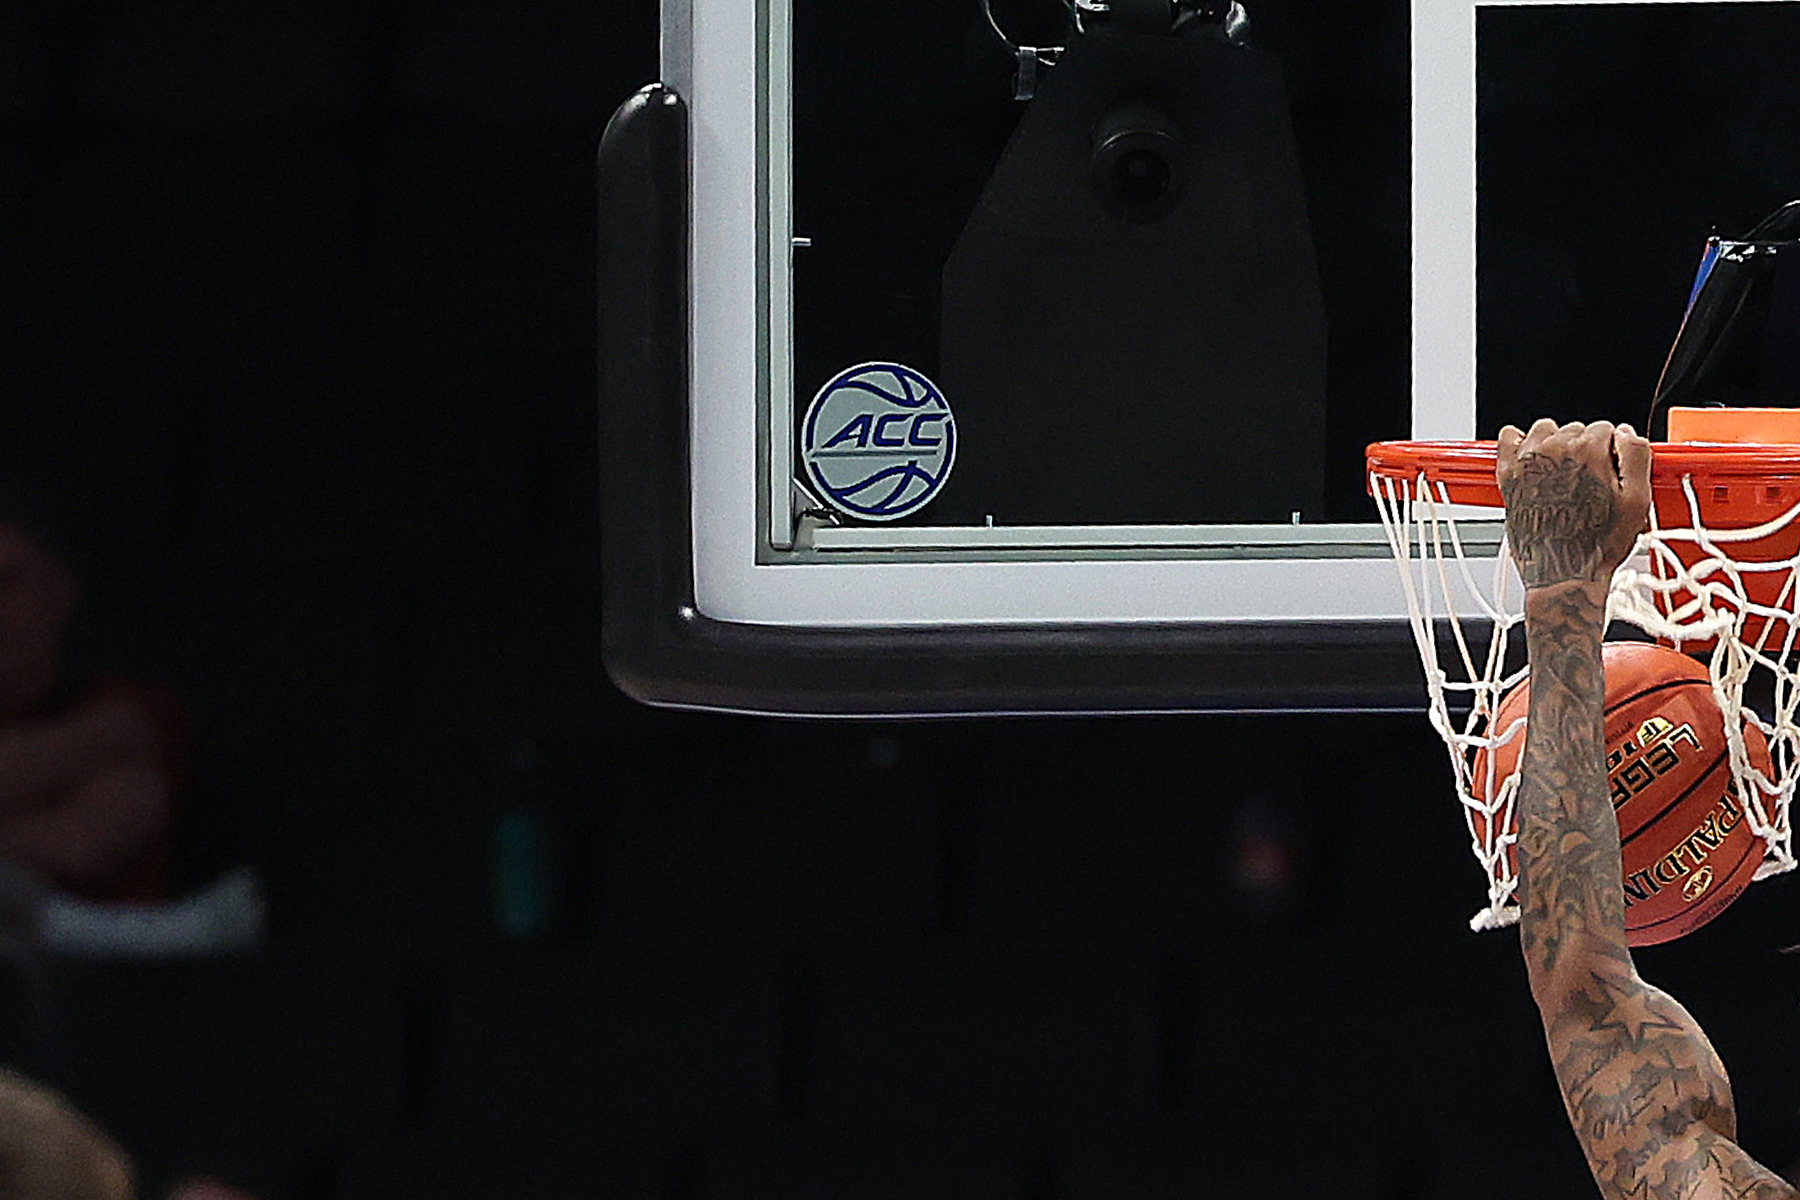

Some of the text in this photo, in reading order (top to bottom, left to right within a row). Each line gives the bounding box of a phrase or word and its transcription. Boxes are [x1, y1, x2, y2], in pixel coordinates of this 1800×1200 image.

[821, 413, 950, 449] ACC
[1610, 722, 1704, 813] LEGA
[1624, 778, 1746, 909] PALDIN
